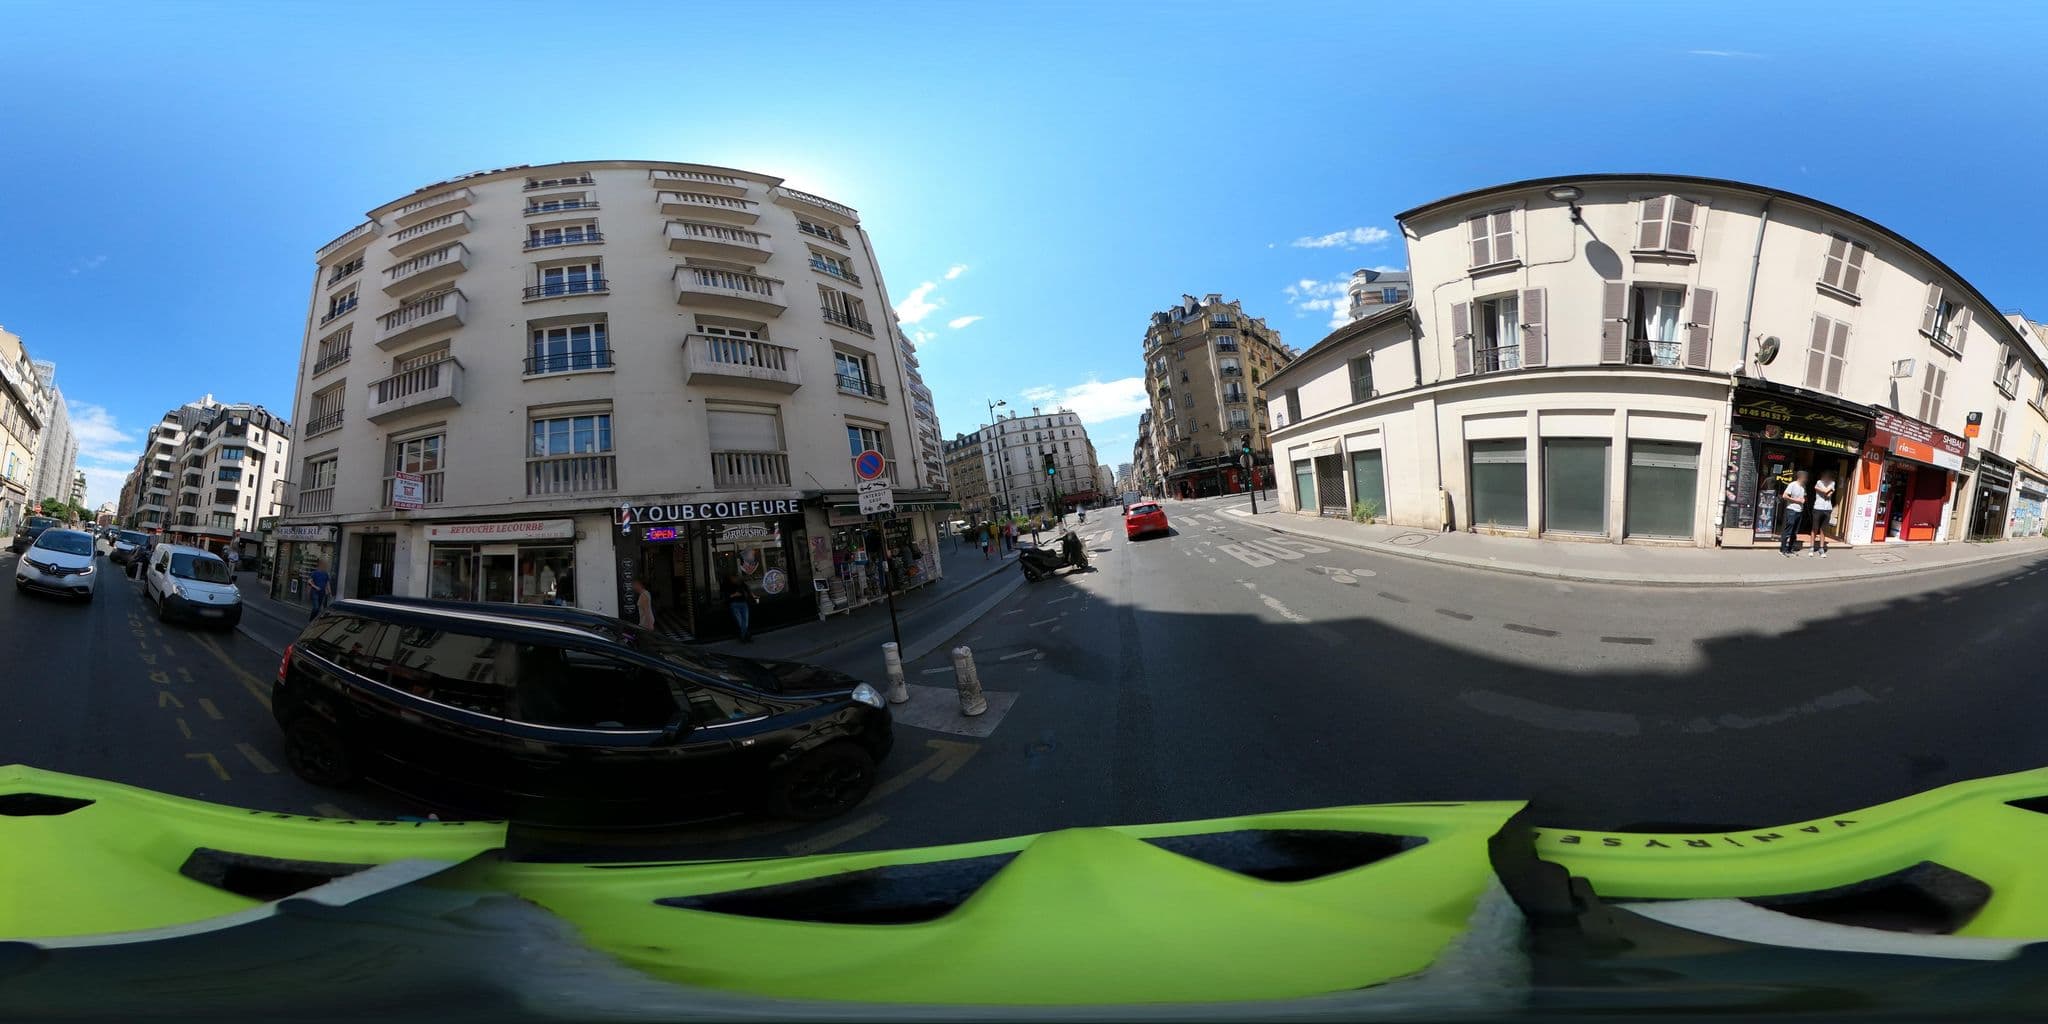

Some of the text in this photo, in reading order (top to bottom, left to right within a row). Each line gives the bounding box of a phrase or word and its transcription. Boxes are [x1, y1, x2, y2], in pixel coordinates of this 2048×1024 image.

[1783, 431, 1811, 443] PIZZA
[911, 504, 937, 512] BAZAR
[450, 522, 544, 534] RETOUCHE LECOURBE
[651, 529, 674, 539] OPEN
[1216, 536, 1331, 568] BUS
